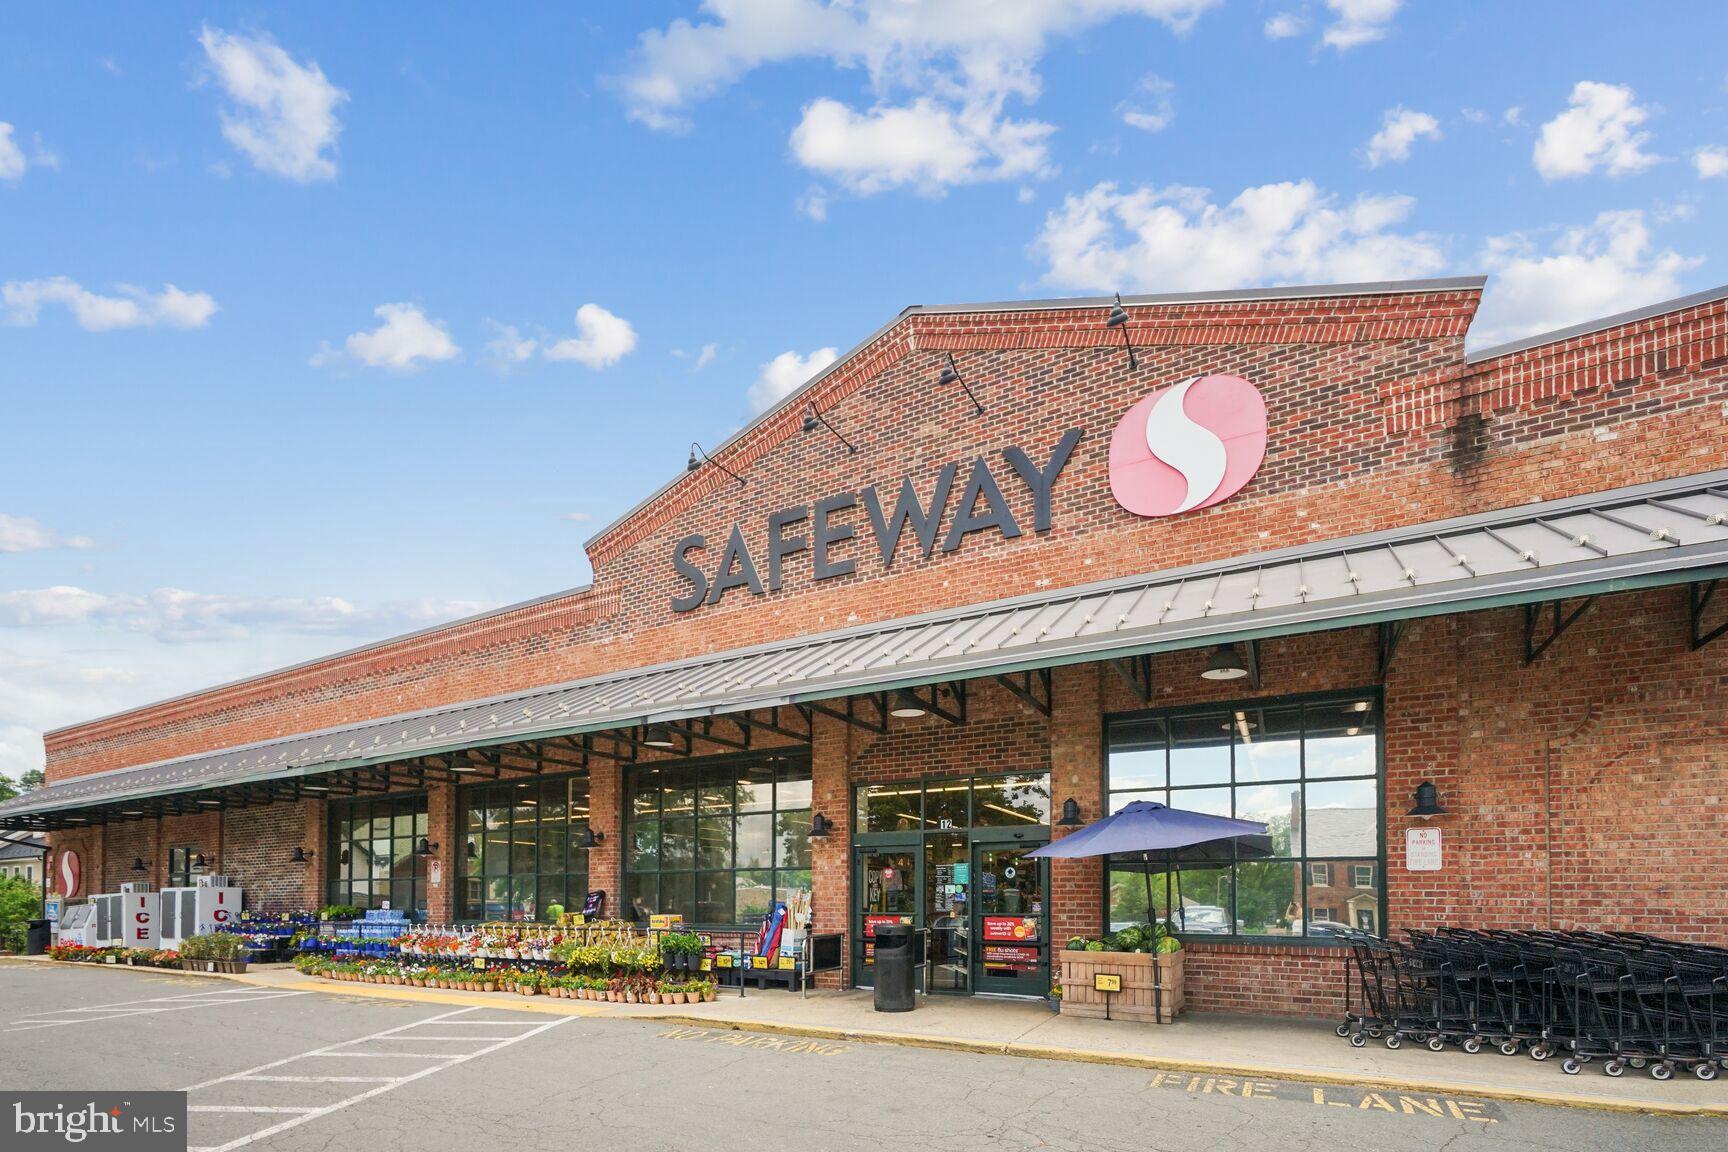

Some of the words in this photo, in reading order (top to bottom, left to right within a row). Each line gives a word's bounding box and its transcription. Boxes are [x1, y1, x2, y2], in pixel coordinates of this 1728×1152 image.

[671, 426, 1085, 613] SAFEWAY
[941, 819, 952, 829] 12
[136, 896, 151, 940] ICE
[1150, 1073, 1280, 1101] FIRE
[1312, 1087, 1499, 1124] LANE
